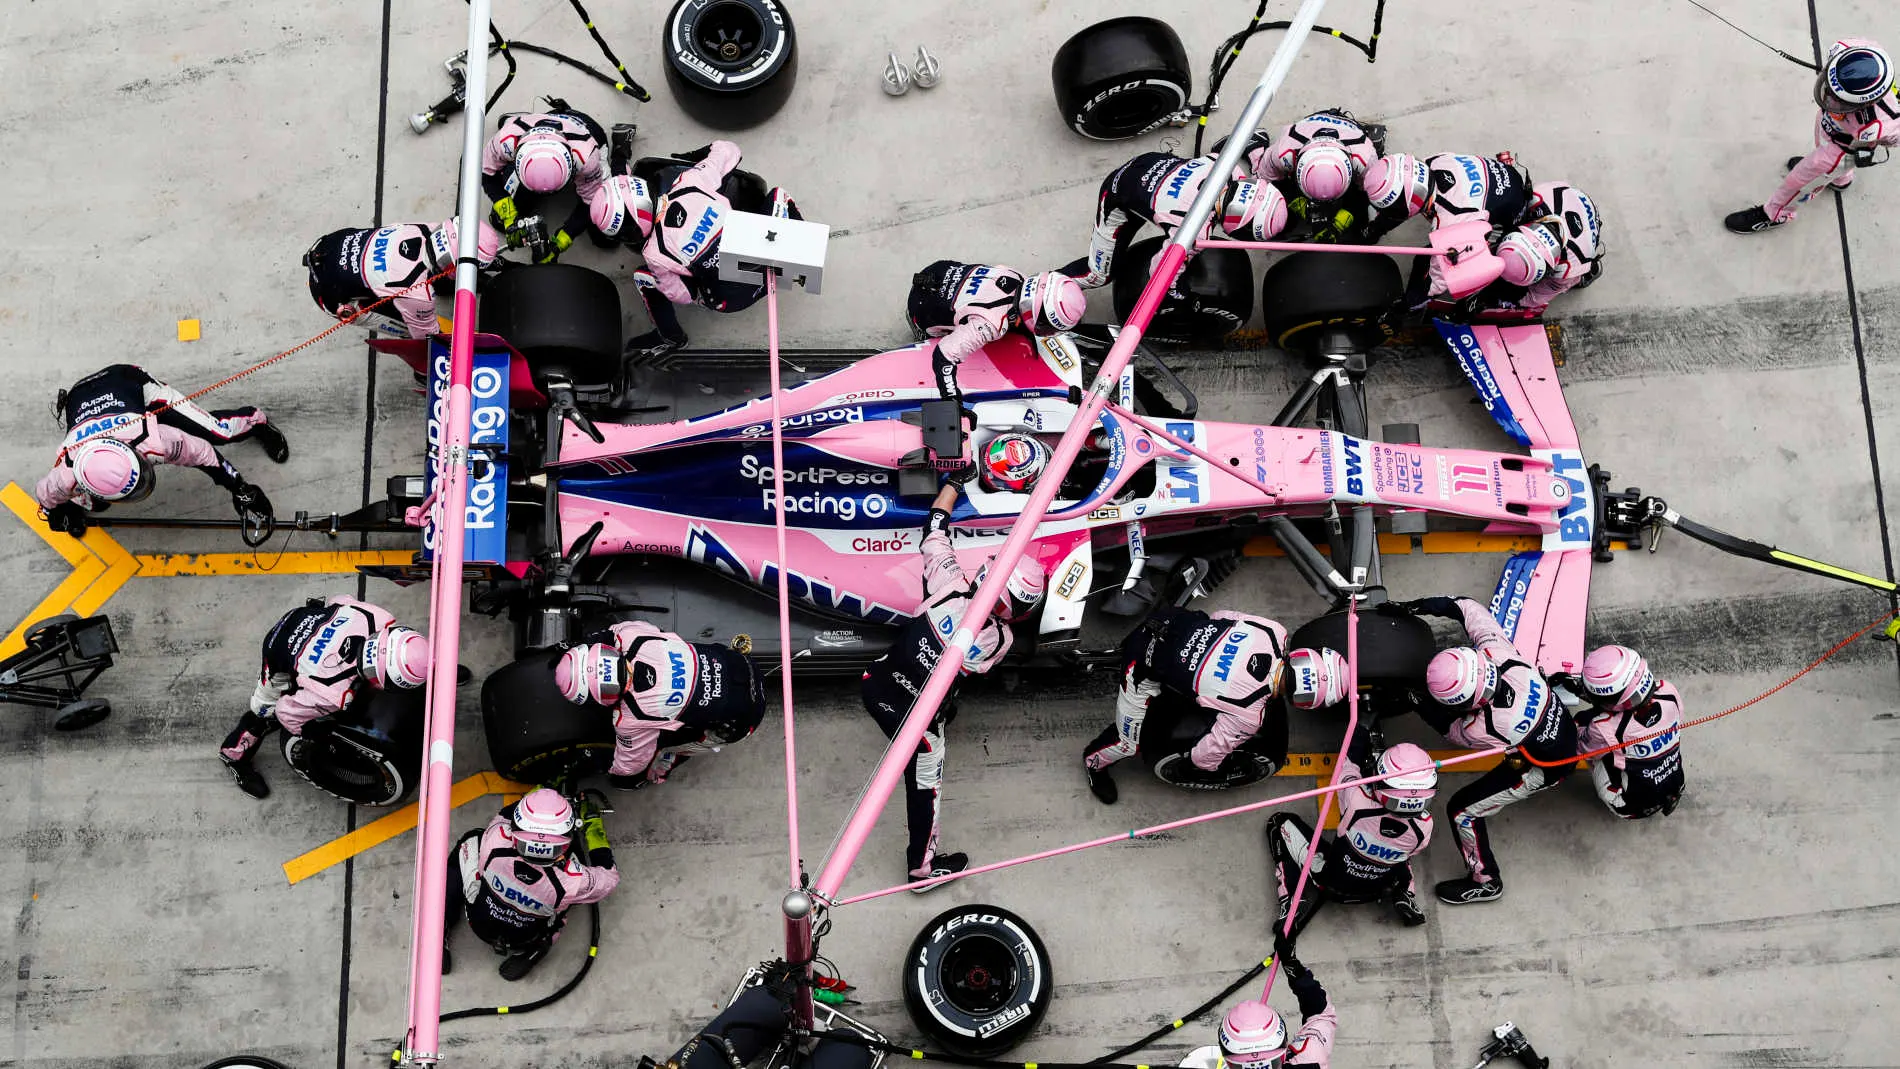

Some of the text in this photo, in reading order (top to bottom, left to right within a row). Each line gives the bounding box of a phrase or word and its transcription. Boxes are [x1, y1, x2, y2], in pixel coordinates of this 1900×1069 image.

[679, 50, 726, 85] PIRELLI
[1829, 67, 1844, 93] BWT
[1084, 80, 1141, 112] ZERO
[1869, 85, 1887, 101] BWT
[1167, 168, 1194, 200] BWT
[1417, 164, 1426, 184] BWT
[1454, 156, 1479, 184] BWT
[635, 178, 645, 197] BWT
[1238, 184, 1252, 204] BWT
[1382, 191, 1397, 206] BWT
[611, 212, 622, 229] BWT
[693, 207, 719, 244] BWT
[1579, 196, 1594, 228] BWT
[339, 234, 354, 267] Racing
[434, 231, 447, 253] BWT
[1537, 228, 1556, 247] BWT
[374, 238, 389, 273] BWT
[966, 267, 990, 296] BWT
[1024, 278, 1034, 298] BWT
[1052, 318, 1067, 331] BWT
[1202, 307, 1238, 321] ERO
[1047, 338, 1073, 370] JCB
[1470, 348, 1501, 400] Racing
[80, 393, 113, 410] Racing
[846, 390, 895, 400] Claro
[75, 400, 126, 424] SportPesa
[772, 406, 864, 428] Racing
[76, 419, 112, 442] BWT
[1115, 426, 1126, 470] SportPesa
[464, 405, 506, 529] Racing
[740, 455, 889, 485] SportPesa
[1014, 469, 1033, 479] NEC
[1320, 431, 1334, 494] BOMBARDIER
[1343, 435, 1363, 496] BWT
[1374, 446, 1384, 492] SportPesa
[1386, 457, 1394, 487] Racing
[1396, 453, 1409, 492] JCB
[1411, 454, 1424, 494] NEC
[120, 470, 139, 495] BWT
[1096, 477, 1111, 494] BWT
[1437, 454, 1450, 500] PIRELLI
[1451, 463, 1491, 495] 11
[1493, 460, 1503, 507] infinitum
[763, 489, 856, 521] Racing
[1552, 453, 1591, 542] BWT
[1089, 509, 1119, 519] JCB
[852, 536, 903, 553] Claro
[954, 527, 1014, 538] NEC
[1130, 530, 1141, 555] NEC
[623, 541, 681, 554] Acronis
[1061, 562, 1084, 597] JCB
[1503, 597, 1523, 639] acing
[309, 627, 336, 665] BWT
[364, 641, 373, 665] BWT
[1180, 628, 1204, 658] Racing
[1188, 624, 1218, 672] SportPesa
[603, 658, 612, 682] BWT
[668, 651, 686, 690] BWT
[1214, 641, 1240, 682] BWT
[1488, 664, 1496, 687] BWT
[699, 654, 709, 706] SportPesa
[711, 661, 722, 697] Racing
[1302, 668, 1312, 692] BWT
[1596, 686, 1614, 694] BWT
[1640, 673, 1653, 695] BWT
[1525, 680, 1541, 720] BWT
[1537, 693, 1556, 743] SportPesa
[1549, 704, 1563, 741] Racing
[1651, 722, 1678, 753] BWT
[1300, 757, 1311, 766] 10
[1400, 801, 1423, 809] BWT
[527, 845, 552, 855] BWT
[1367, 844, 1404, 863] BWT
[1347, 867, 1378, 881] Racing
[485, 896, 536, 922] SportPesa
[504, 888, 544, 910] BWT
[490, 910, 524, 928] Racing
[919, 913, 1000, 966] P ZERO
[978, 1002, 1031, 1039] PIRELLI
